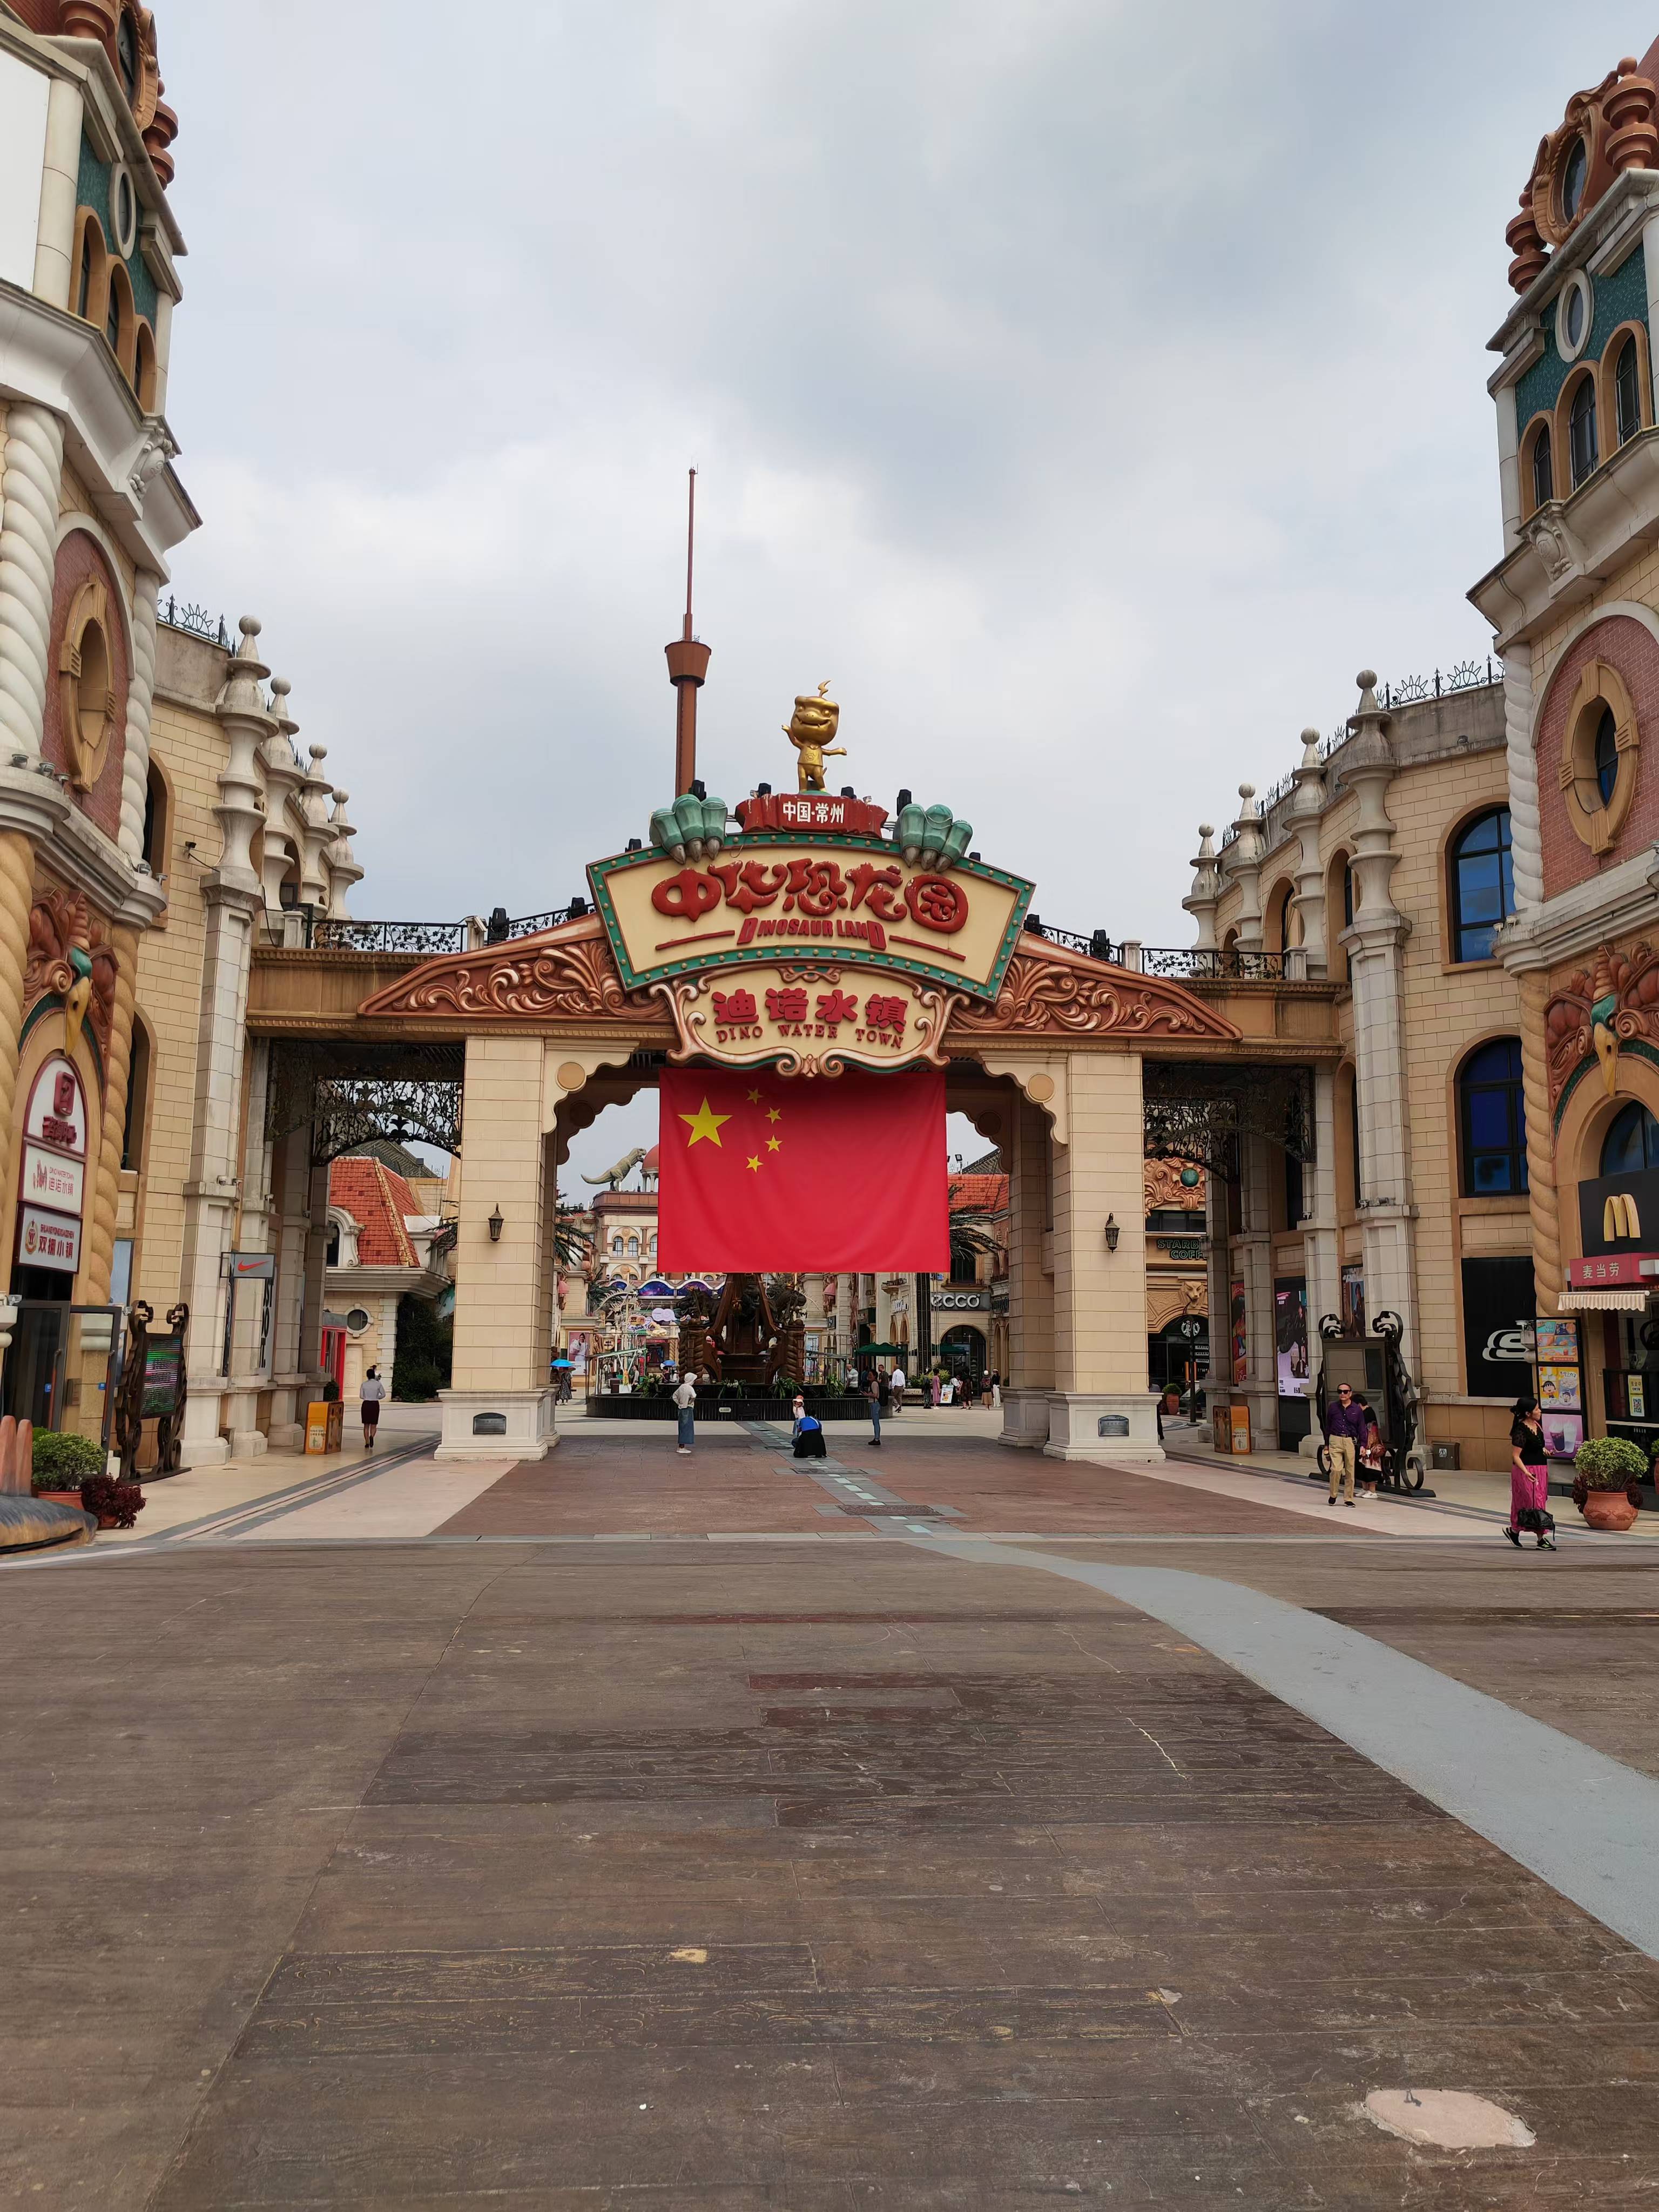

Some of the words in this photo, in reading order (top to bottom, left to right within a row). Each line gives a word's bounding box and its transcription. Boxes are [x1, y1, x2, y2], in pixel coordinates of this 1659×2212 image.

[783, 801, 844, 824] 中国·常州
[651, 858, 968, 933] 中华恐龙园
[737, 917, 833, 945] DINOSAUR
[836, 919, 887, 950] LAND
[711, 988, 908, 1033] 迪诺水镇
[716, 1026, 763, 1043] DINO
[778, 1023, 838, 1038] WATER
[855, 1028, 904, 1049] TOWN
[1171, 1250, 1205, 1259] COFF
[1583, 1262, 1620, 1279] 麦当劳
[930, 1294, 980, 1307] ecco
